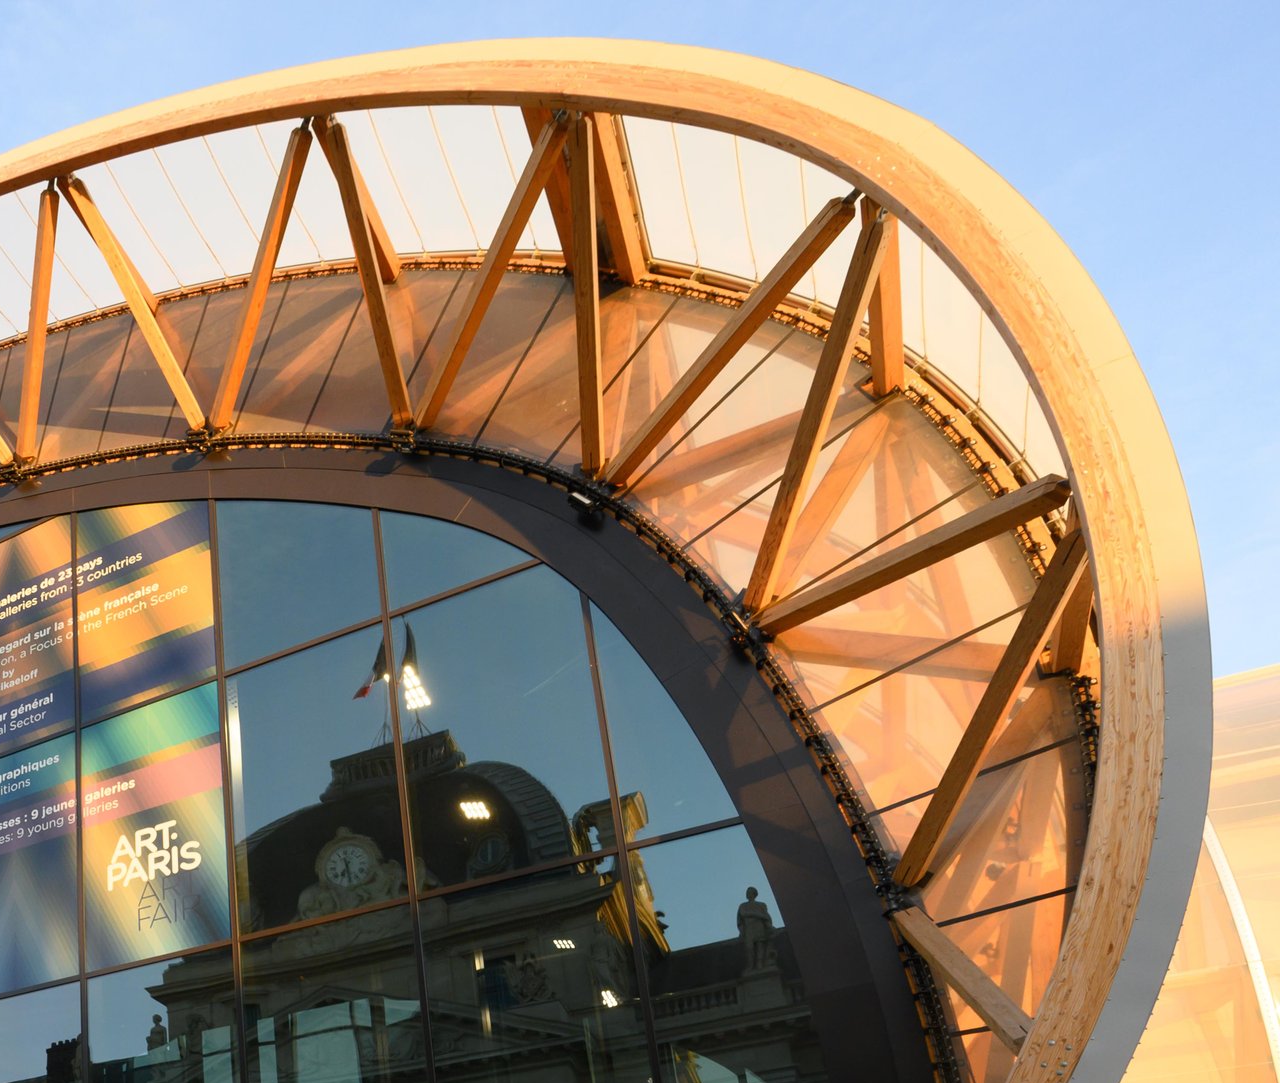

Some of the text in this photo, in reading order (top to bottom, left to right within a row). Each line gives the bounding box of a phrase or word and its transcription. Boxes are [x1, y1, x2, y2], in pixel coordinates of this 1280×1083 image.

[40, 577, 55, 589] de
[58, 568, 72, 582] 23
[77, 556, 102, 577] pays
[40, 585, 67, 603] from
[70, 577, 83, 590] 3
[87, 552, 142, 582] countries
[30, 636, 62, 654] Focus
[84, 619, 102, 633] the
[106, 601, 147, 624] French
[151, 585, 188, 606] Scene
[34, 627, 51, 640] sur
[54, 621, 64, 631] la
[68, 607, 100, 626] sène
[104, 583, 159, 611] française
[3, 668, 15, 680] by
[10, 693, 53, 718] général
[10, 711, 46, 731] Sector
[31, 810, 38, 819] 9
[41, 799, 76, 818] jeune
[85, 779, 135, 804] galeries
[17, 828, 24, 838] 9
[28, 816, 64, 838] young
[68, 799, 118, 824] glleries
[107, 841, 201, 891] PARIS
[138, 871, 197, 906] ART
[138, 895, 205, 931] FAIR
